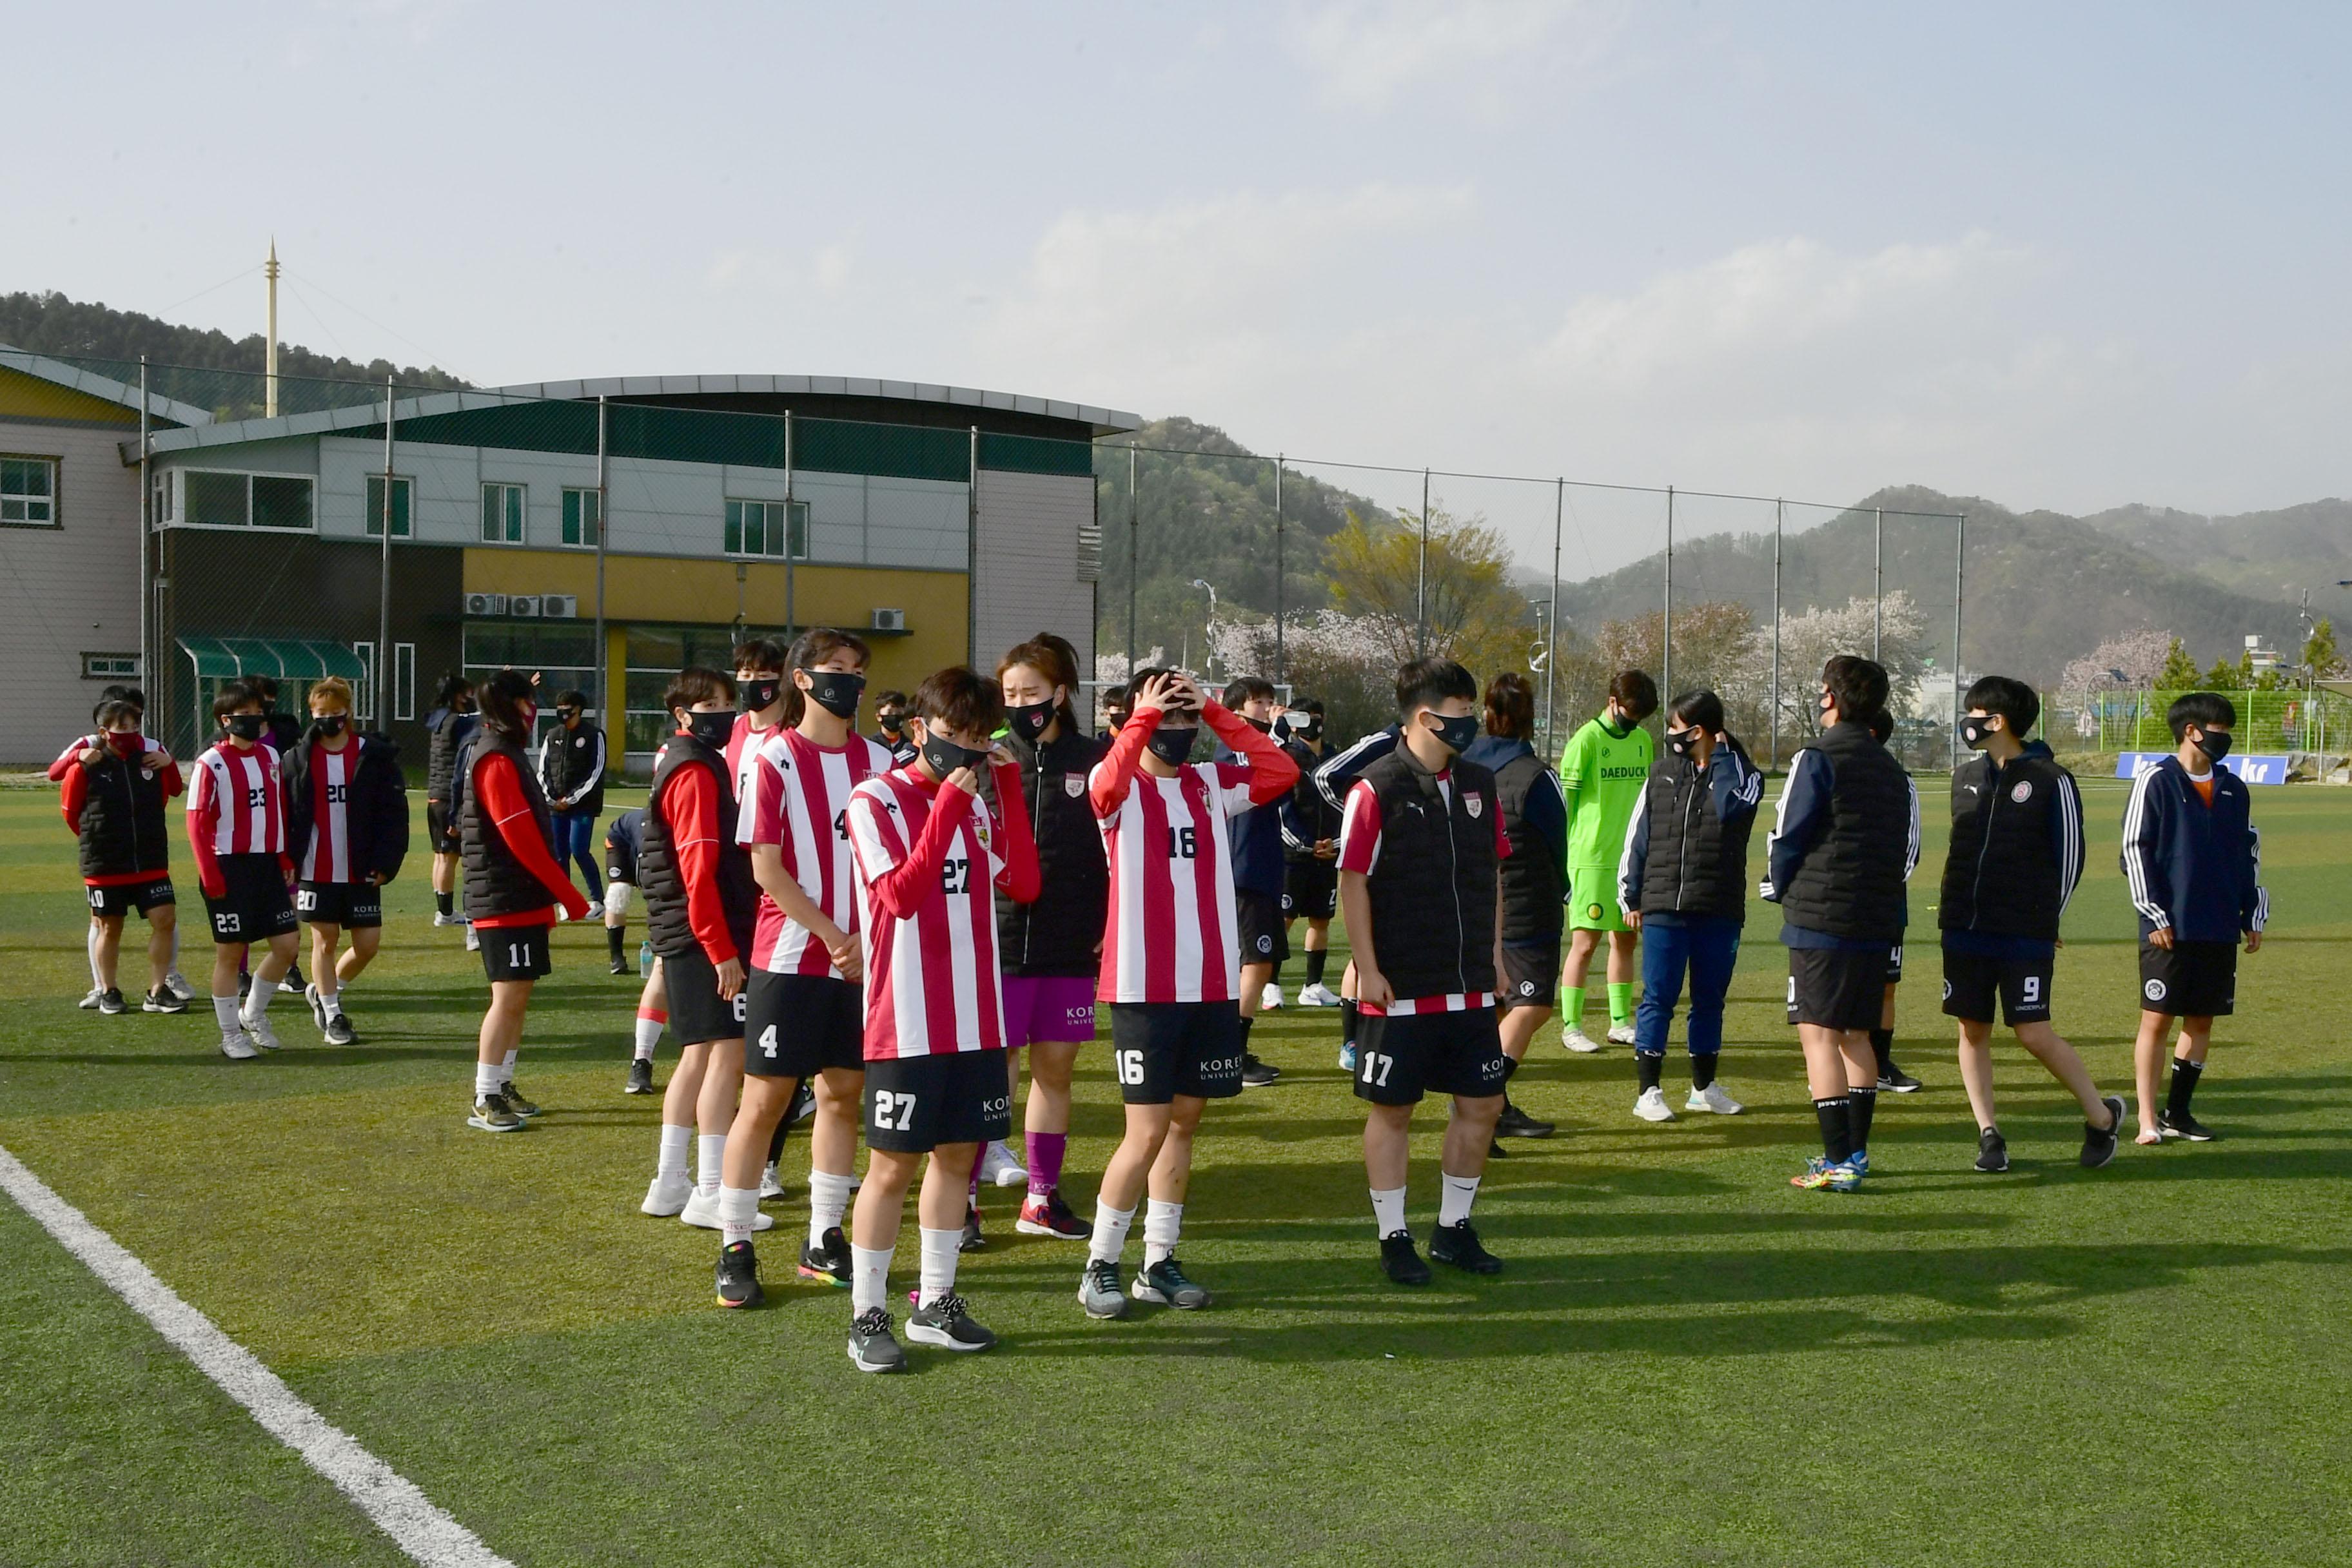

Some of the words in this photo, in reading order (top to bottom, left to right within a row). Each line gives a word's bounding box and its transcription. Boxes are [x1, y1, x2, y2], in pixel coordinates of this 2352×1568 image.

[1600, 767, 1646, 779] DAEDUCK
[249, 788, 266, 808] 23
[327, 785, 347, 803] 20
[1168, 827, 1197, 858] 16
[942, 859, 970, 894] 27
[297, 890, 318, 911] 20
[215, 913, 241, 933] 23
[509, 943, 531, 967] 11
[2023, 976, 2039, 1003] 9
[732, 993, 747, 1022] 6
[758, 1024, 778, 1058] 4
[1115, 1049, 1145, 1085] 16
[1361, 1051, 1393, 1088] 17
[874, 1090, 917, 1131] 27
